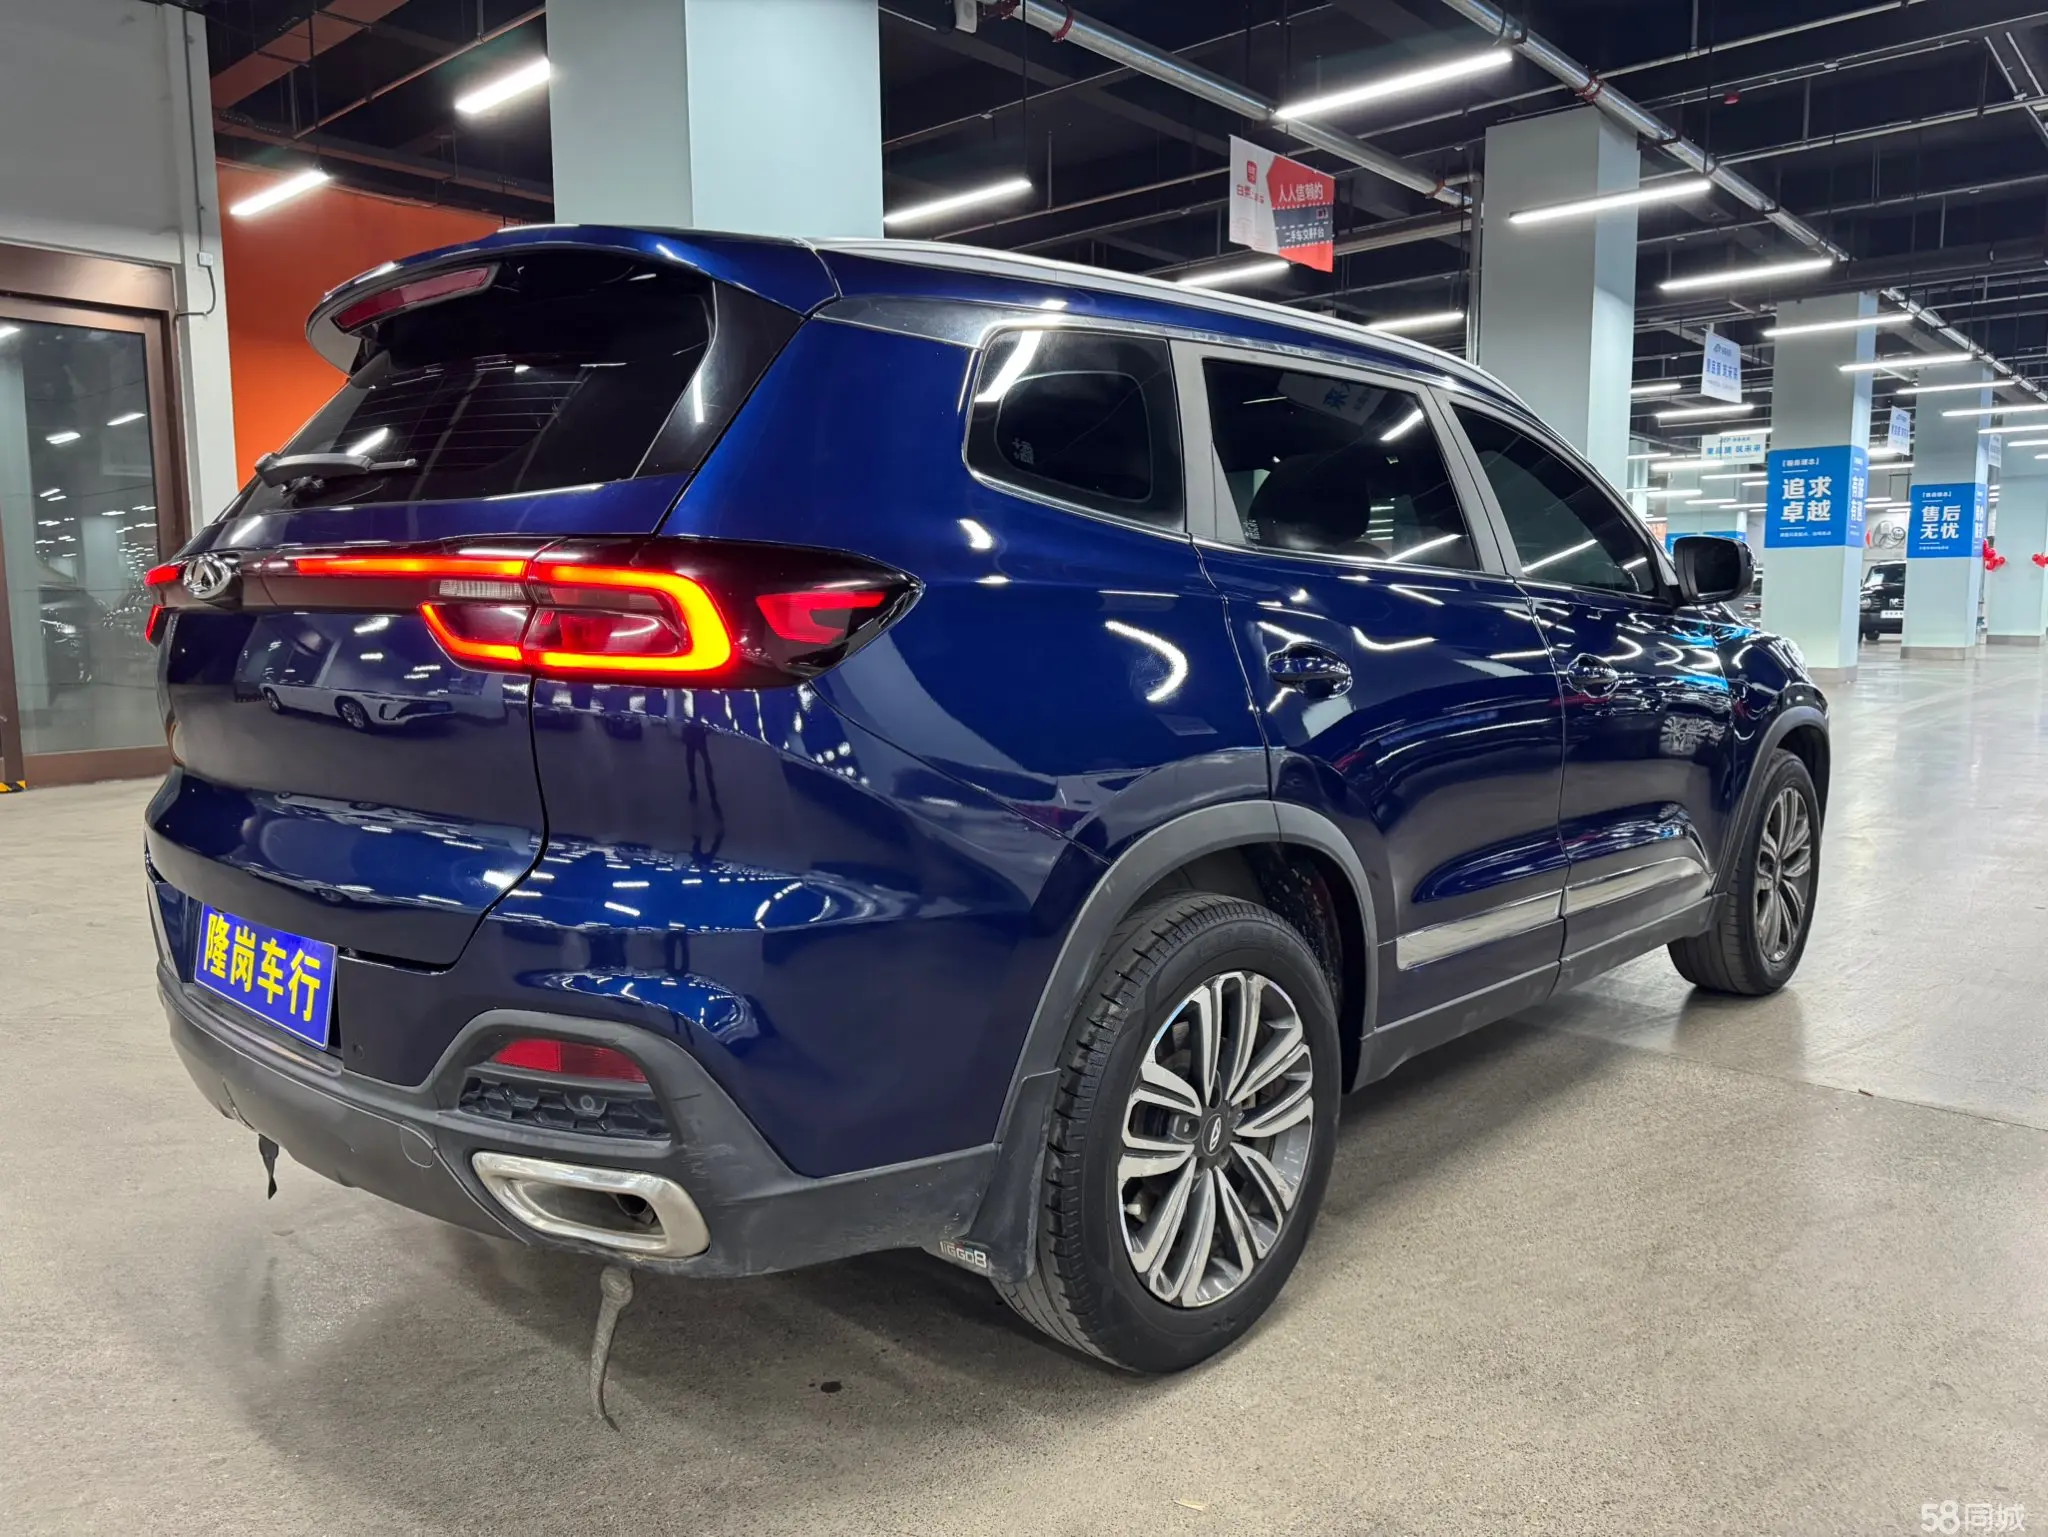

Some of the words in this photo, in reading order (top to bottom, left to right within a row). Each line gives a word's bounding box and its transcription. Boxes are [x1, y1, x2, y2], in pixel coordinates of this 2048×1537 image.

[1279, 182, 1324, 203] 人人信赖的
[1781, 476, 1832, 500] 追求
[1780, 499, 1831, 523] 卓越
[1921, 505, 1962, 522] 售后
[1919, 522, 1960, 540] 无忧
[203, 913, 321, 1022] 隆岗车行
